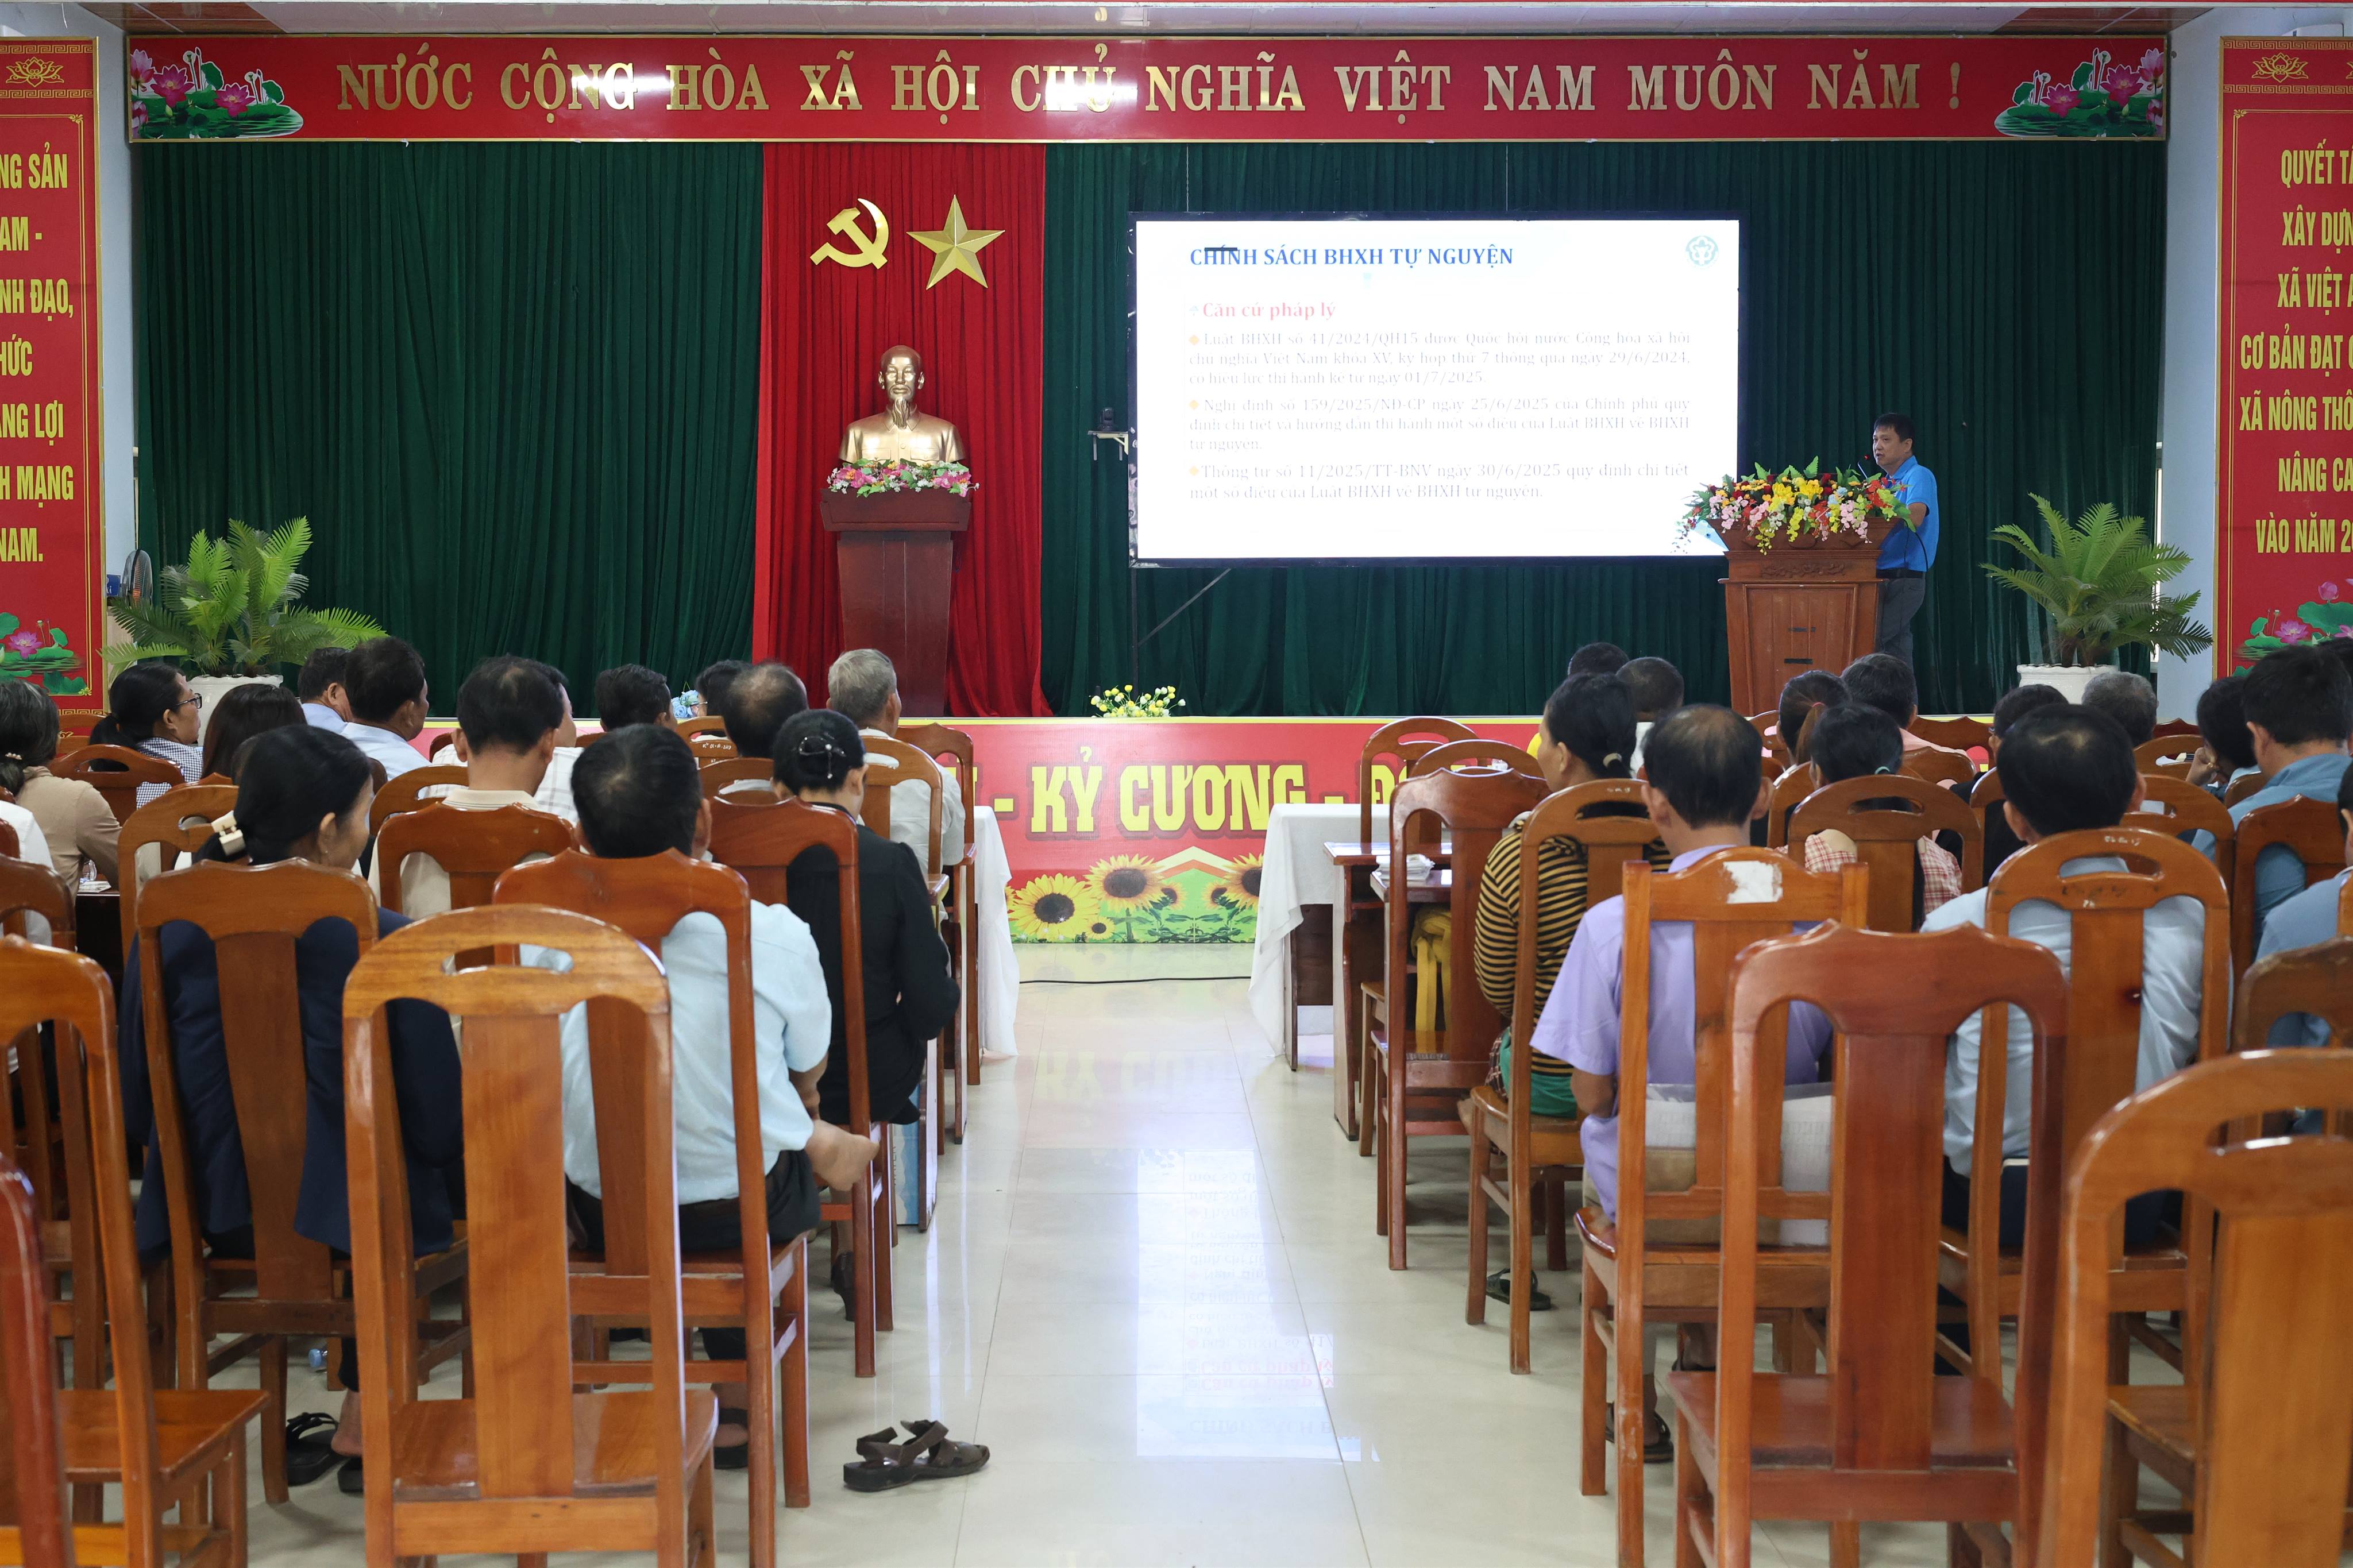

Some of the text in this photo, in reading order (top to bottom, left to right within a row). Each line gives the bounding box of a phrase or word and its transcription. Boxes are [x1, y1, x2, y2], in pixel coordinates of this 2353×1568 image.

[337, 43, 1961, 125] NƯỚC CỘNG HÒA XÃ HỘI CHỦ NGHĨA VIỆT NAM MUÔN NĂM !
[28, 142, 68, 189] SẢN
[2281, 138, 2335, 188] QUYẾT
[2282, 204, 2316, 246] XÂY
[1190, 244, 1513, 269] CHÍNH SÁCH BHXH TỰ NGUYỆN
[30, 279, 74, 322] ĐẠO,
[1202, 300, 1236, 318] Căn
[1269, 300, 1316, 321] pháp
[1321, 300, 1337, 322] lý
[2277, 266, 2301, 308] XÃ
[2306, 265, 2343, 315] VIỆT
[1241, 332, 1282, 345] BHXH
[1309, 332, 1418, 349] 41/2024/QH15
[1296, 352, 1328, 364] Nam
[1482, 352, 1490, 364] 7
[1540, 355, 1566, 367] qua
[2240, 331, 2265, 370] CƠ
[2269, 323, 2305, 369] BẢN
[2310, 335, 2344, 377] ĐẠT
[0, 400, 64, 446] NG LỢI
[1470, 398, 1549, 414] 25/6/2025
[1664, 401, 1691, 413] quy
[1585, 416, 1625, 429] BHXH
[1649, 416, 1689, 429] BHXH
[2239, 389, 2353, 431] XÃ NÔNG THÔ
[16, 465, 74, 508] MẠNG
[1299, 465, 1432, 481] 11/2025/TT-BNV
[1477, 464, 1561, 480] 30/6/2025
[1566, 468, 1594, 480] quy
[1348, 485, 1391, 498] BHXH
[1416, 485, 1461, 498] BHXH
[2278, 450, 2353, 492] NÂNG CA
[2255, 512, 2353, 554] VÀO NĂM 2
[1031, 746, 1104, 833] KỶ
[1119, 761, 1306, 831] CƯƠNG
